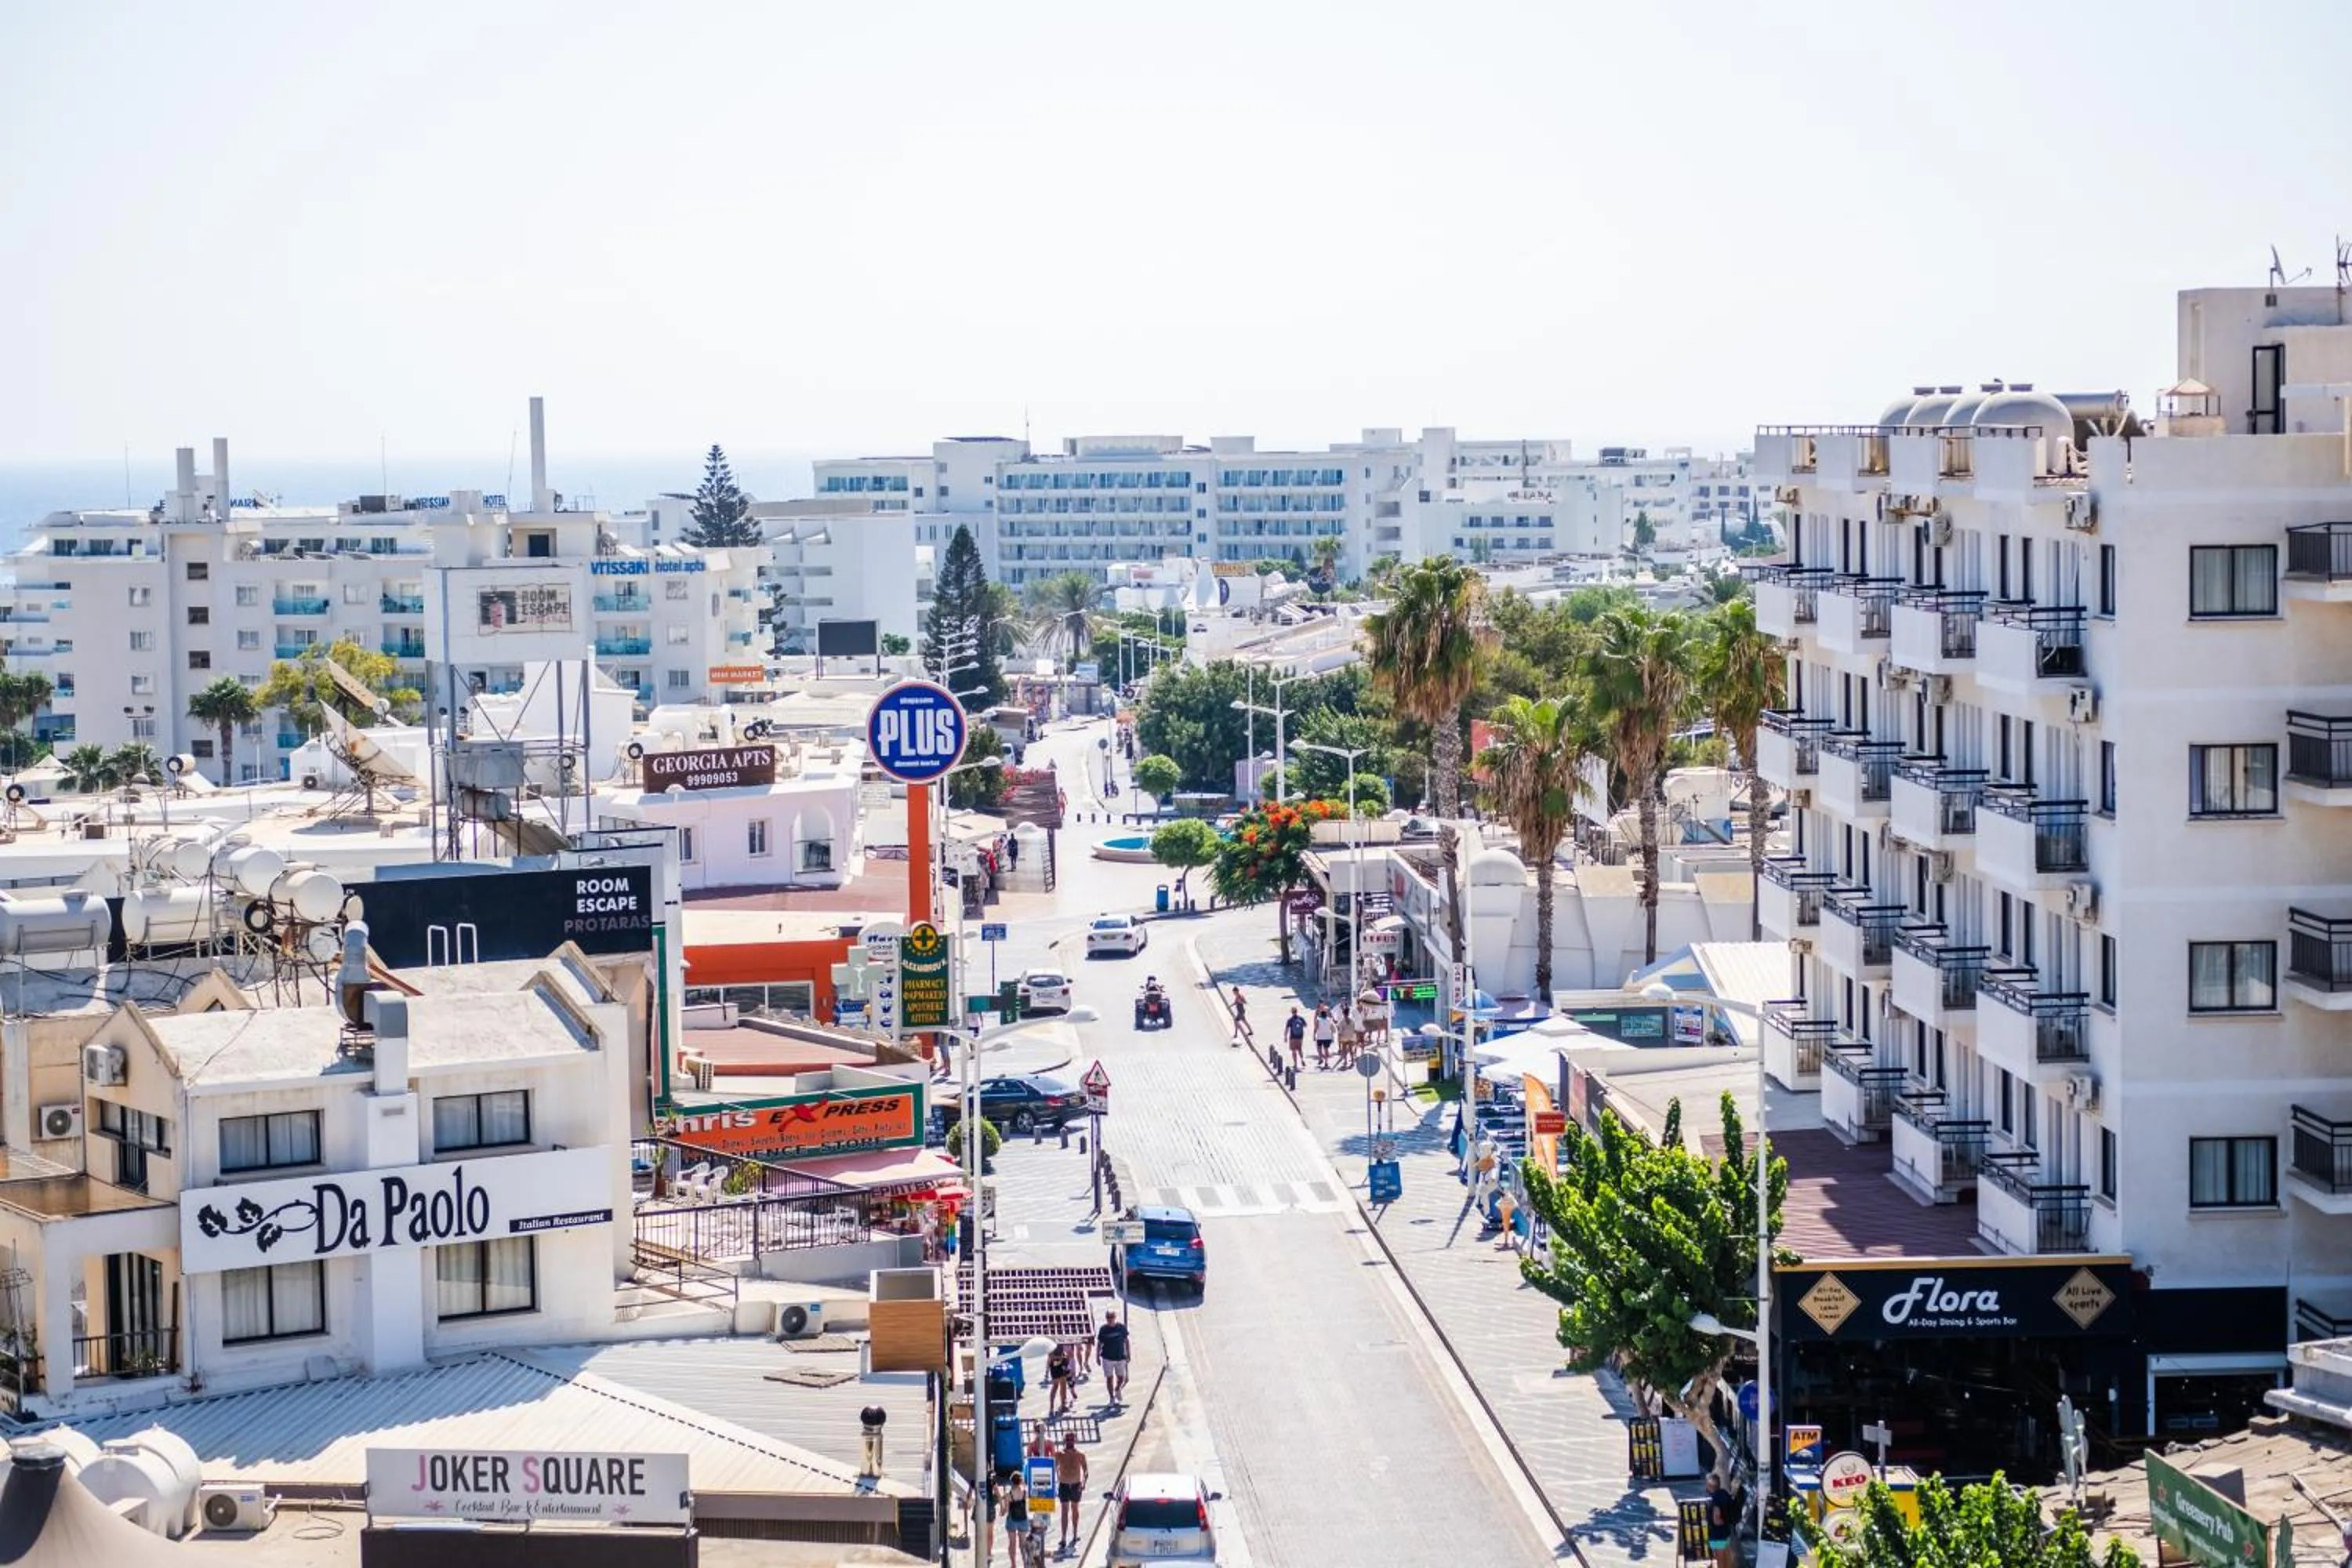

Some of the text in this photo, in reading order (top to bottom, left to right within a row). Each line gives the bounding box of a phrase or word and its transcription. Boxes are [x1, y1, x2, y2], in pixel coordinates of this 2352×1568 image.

[590, 557, 649, 575] vrissaki
[521, 590, 557, 602] ROOM
[522, 602, 568, 615] ESCAPE
[878, 708, 956, 757] PLUS
[652, 750, 771, 774] GEORGIA APTS
[686, 772, 739, 787] 99909053
[576, 877, 630, 895] ROOM
[576, 895, 637, 913] ESCAPE
[564, 915, 651, 933] PROTARAS
[904, 979, 945, 989] PHARMACY
[769, 1098, 900, 1131] EXPRESS
[822, 1136, 886, 1152] STORE
[314, 1165, 490, 1254] Da Paolo
[518, 1213, 604, 1231] Italian Restaurant
[1882, 1277, 2000, 1324] Flora
[1907, 1316, 2018, 1328] All-Day Dining & Sports Bar
[1792, 1431, 1818, 1441] ATM
[412, 1454, 646, 1496] JOKER SQUARE
[1831, 1474, 1867, 1488] KEO
[455, 1500, 495, 1513] Cocktail
[501, 1498, 521, 1518] Bar
[2176, 1490, 2215, 1535] Greenery
[2215, 1515, 2234, 1544] Pub
